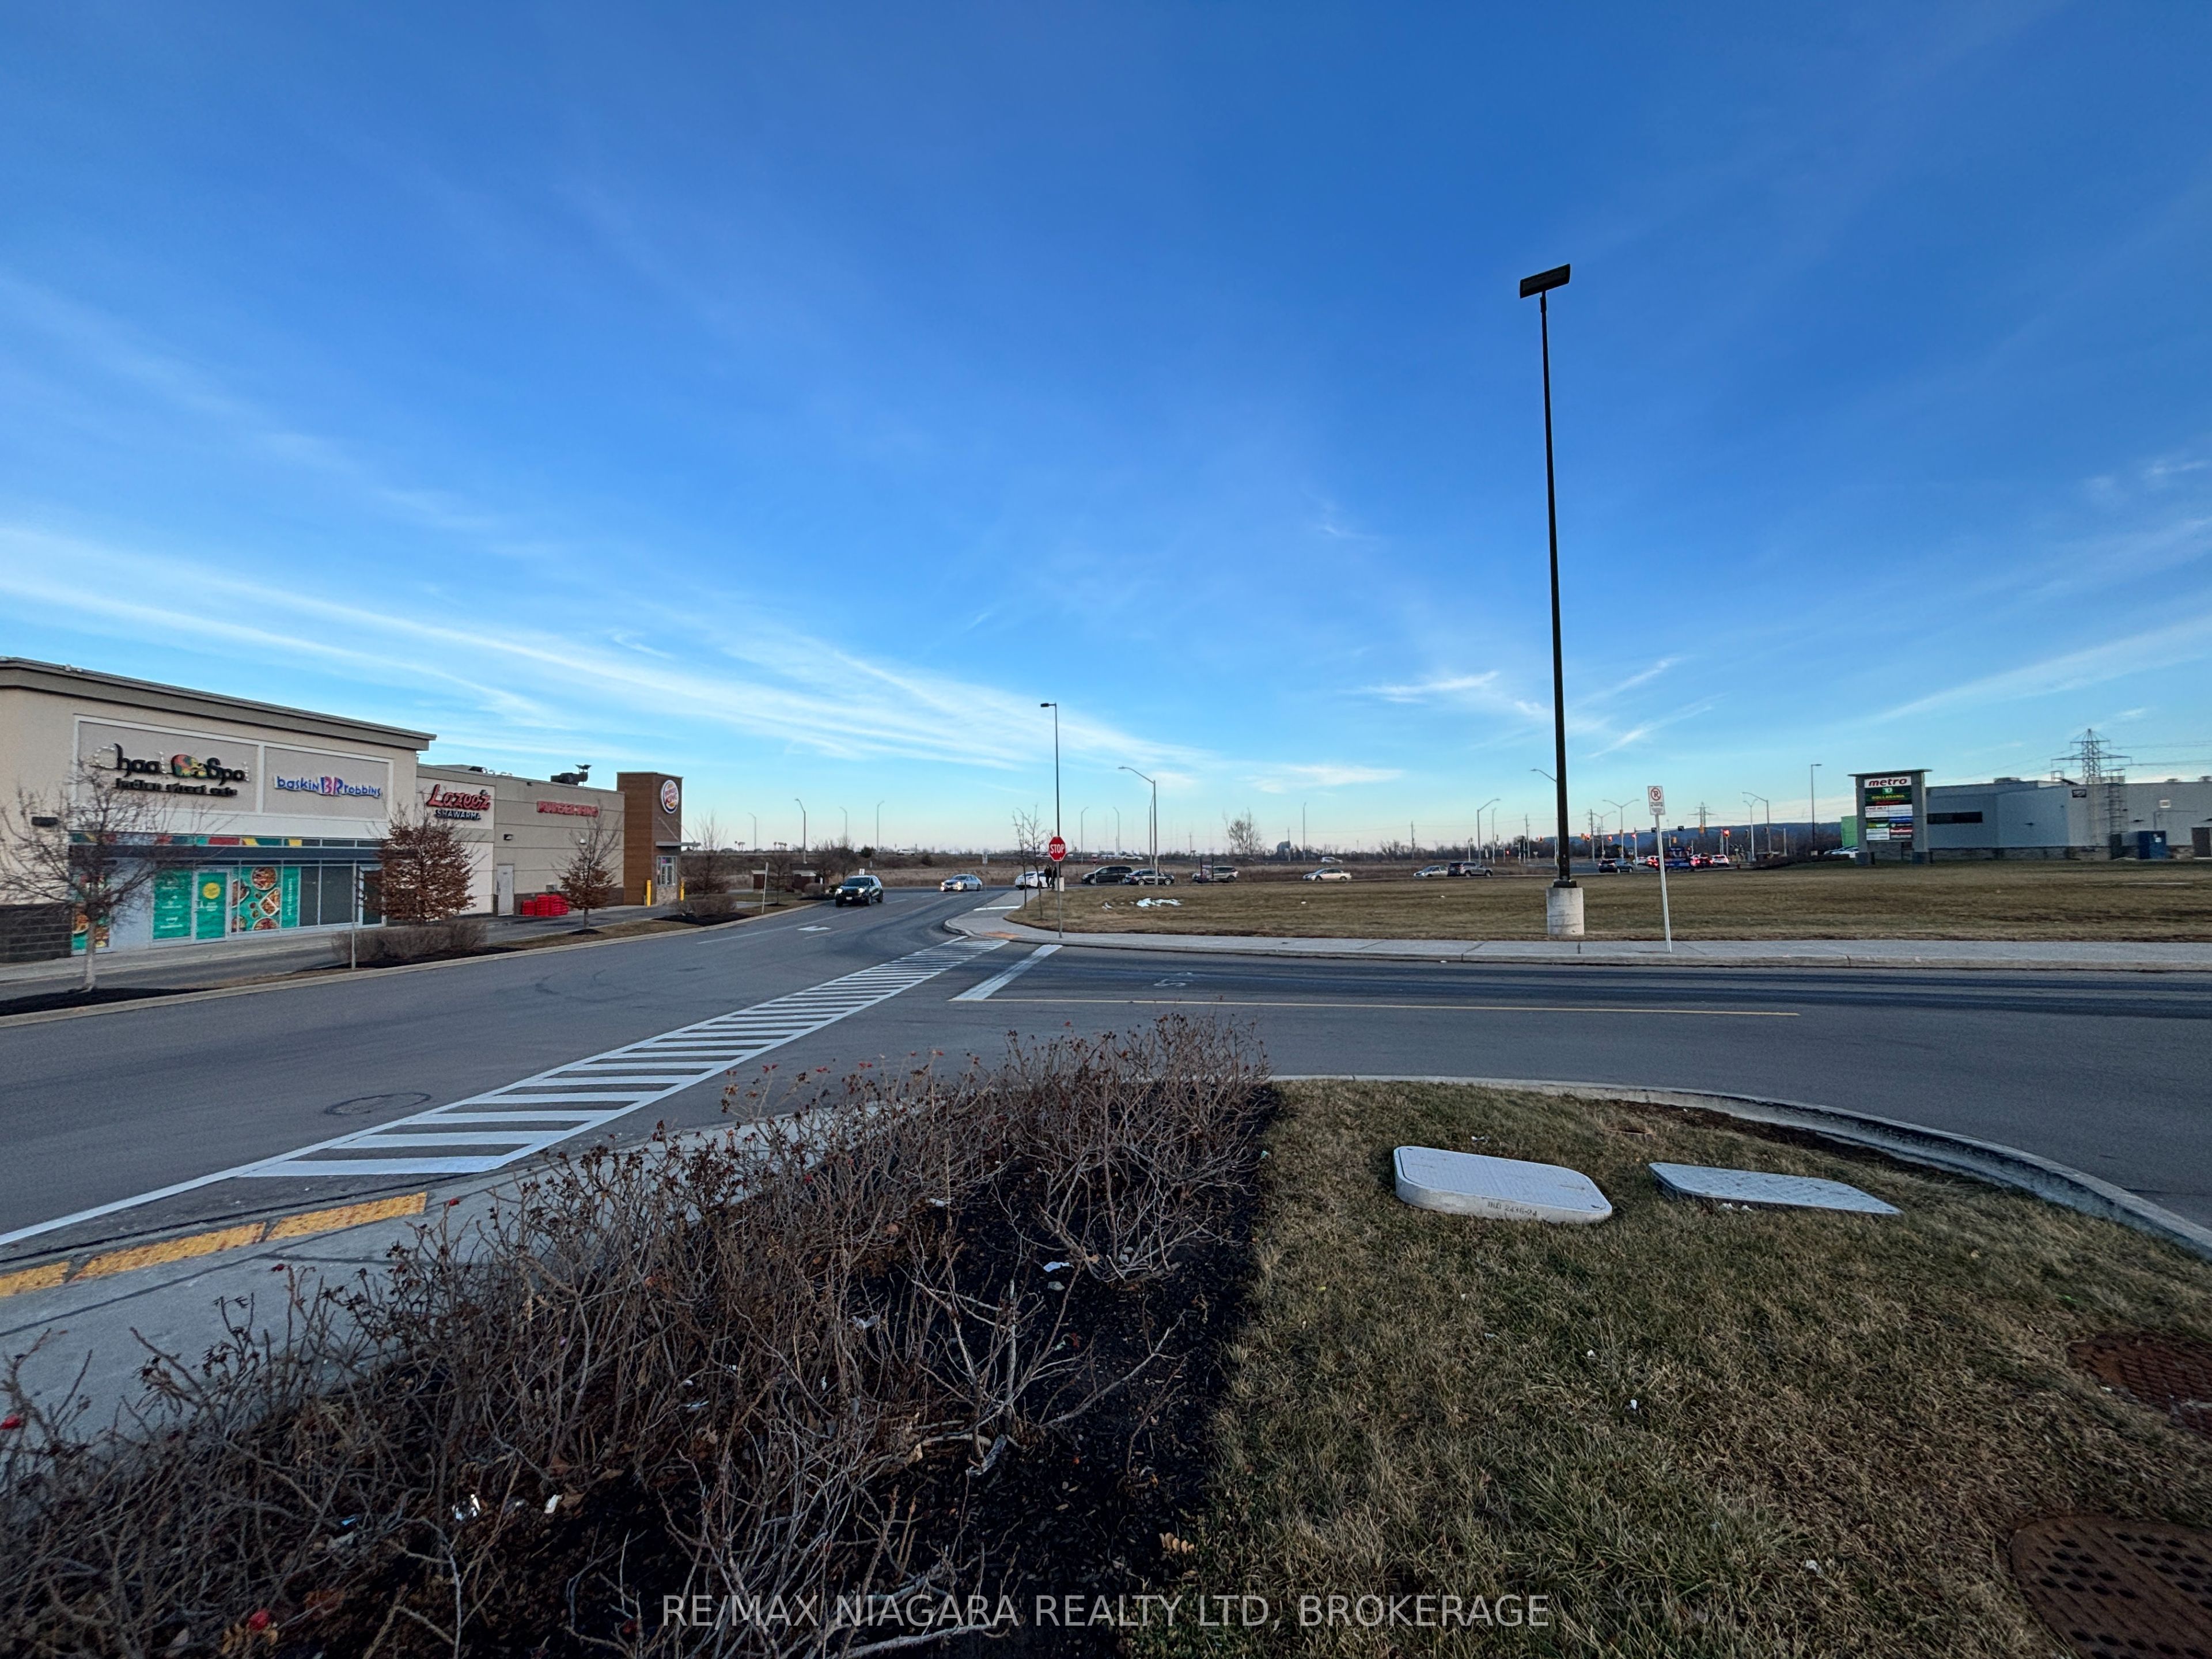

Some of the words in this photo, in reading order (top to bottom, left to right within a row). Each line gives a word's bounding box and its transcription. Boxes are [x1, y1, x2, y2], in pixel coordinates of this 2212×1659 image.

[277, 776, 320, 791] baskin
[344, 784, 381, 797] robbins
[1869, 778, 1907, 786] metro
[426, 783, 491, 811] Lazeez
[436, 809, 482, 820] SHAWARMA
[1050, 843, 1065, 854] STOP
